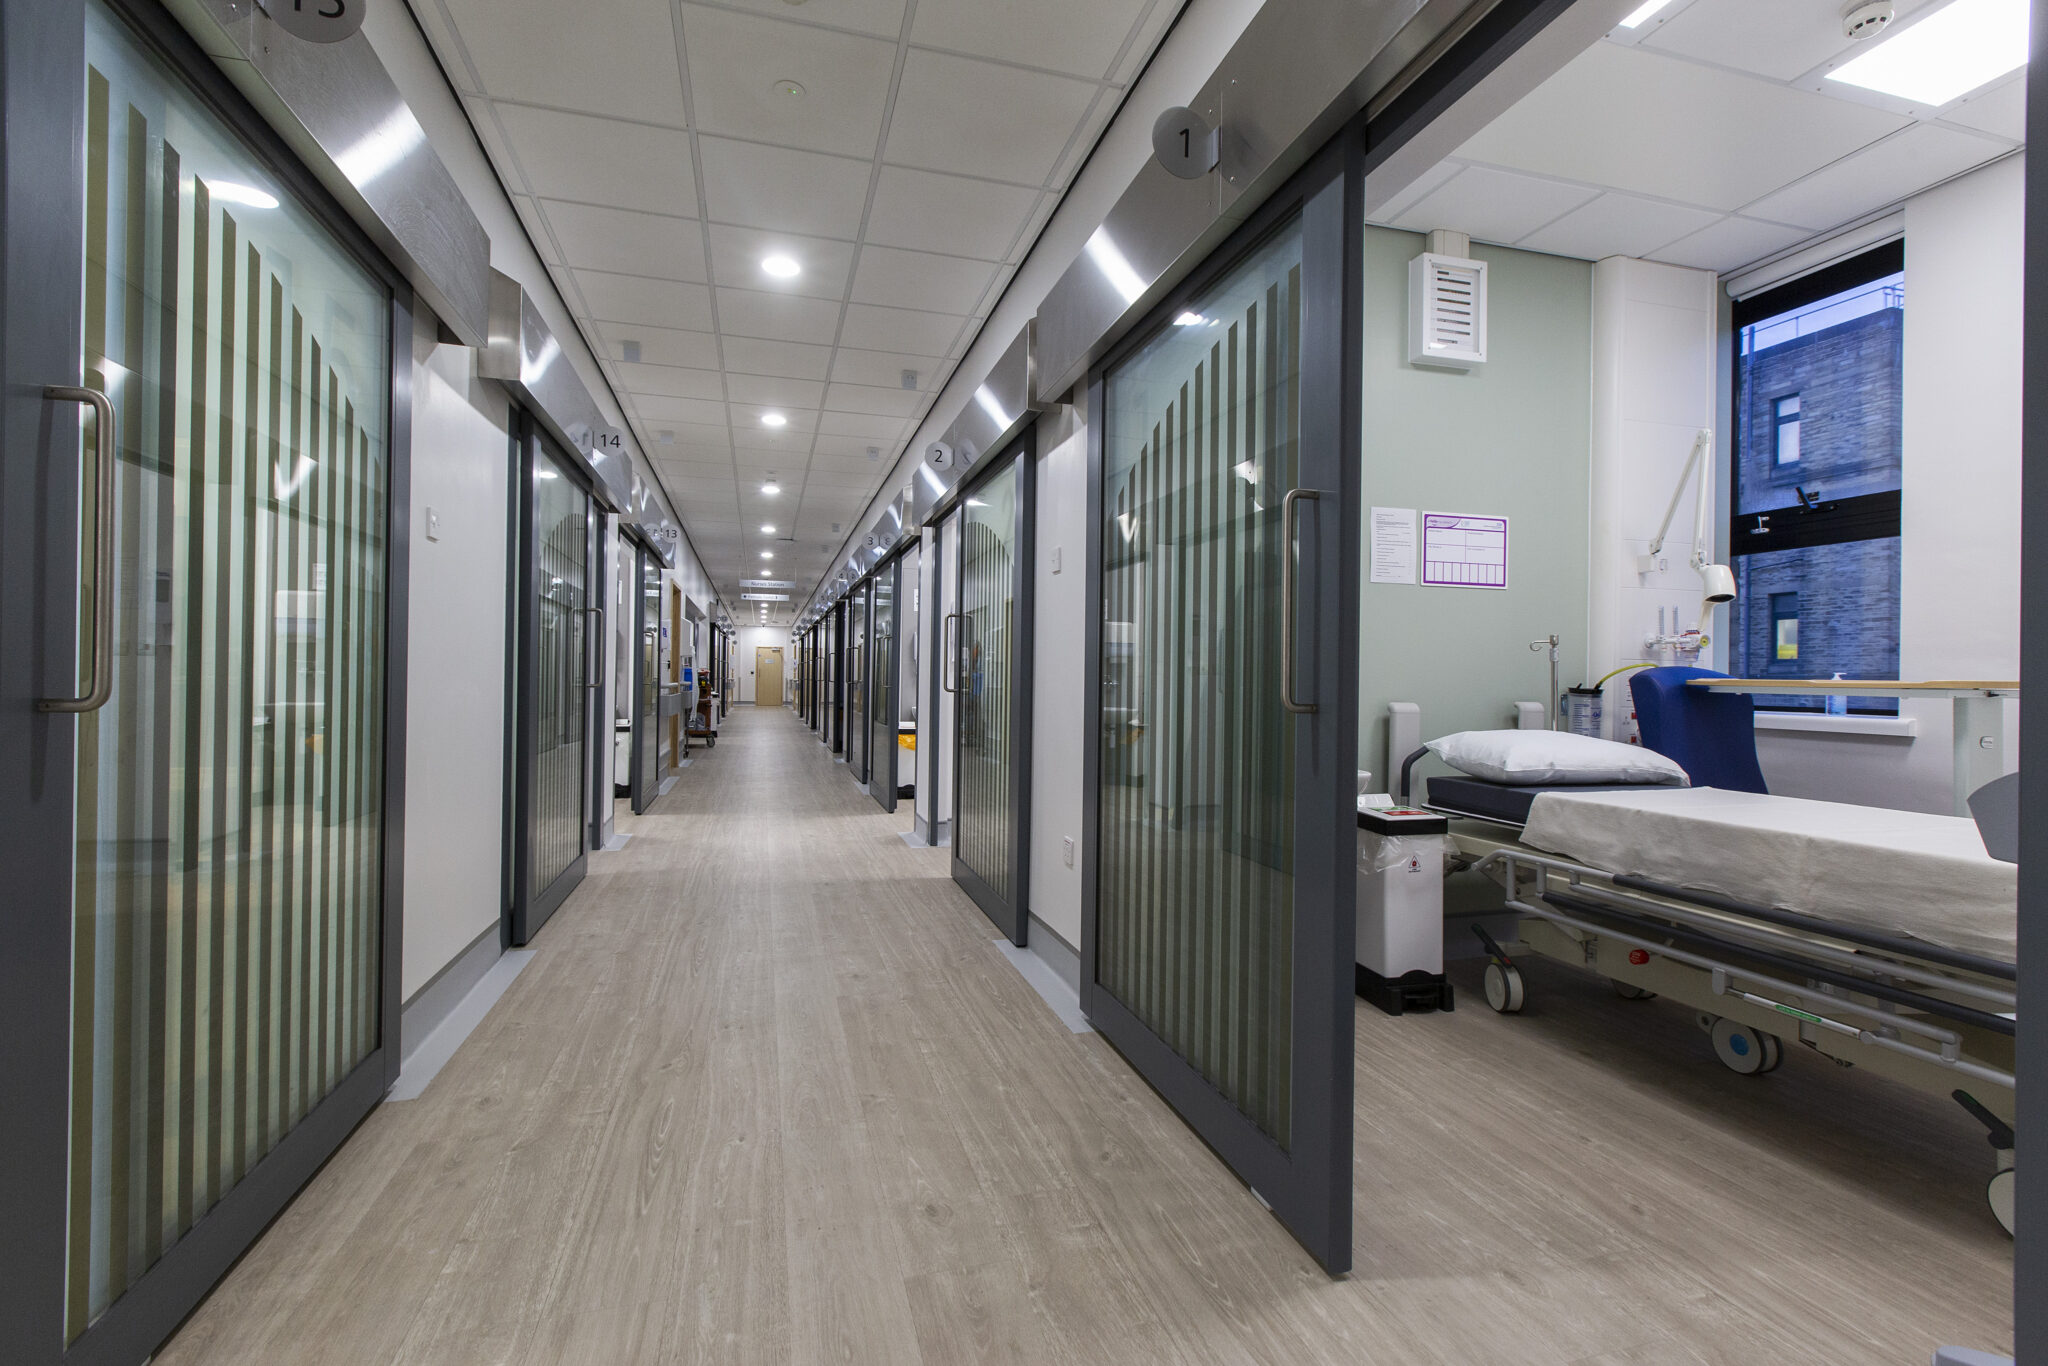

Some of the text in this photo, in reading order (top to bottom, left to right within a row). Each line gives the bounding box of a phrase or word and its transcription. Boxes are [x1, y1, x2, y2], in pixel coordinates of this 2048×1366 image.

[1179, 128, 1190, 158] 1
[600, 434, 621, 448] 14
[934, 449, 943, 463] 2
[665, 529, 678, 539] 13
[867, 536, 874, 546] 3
